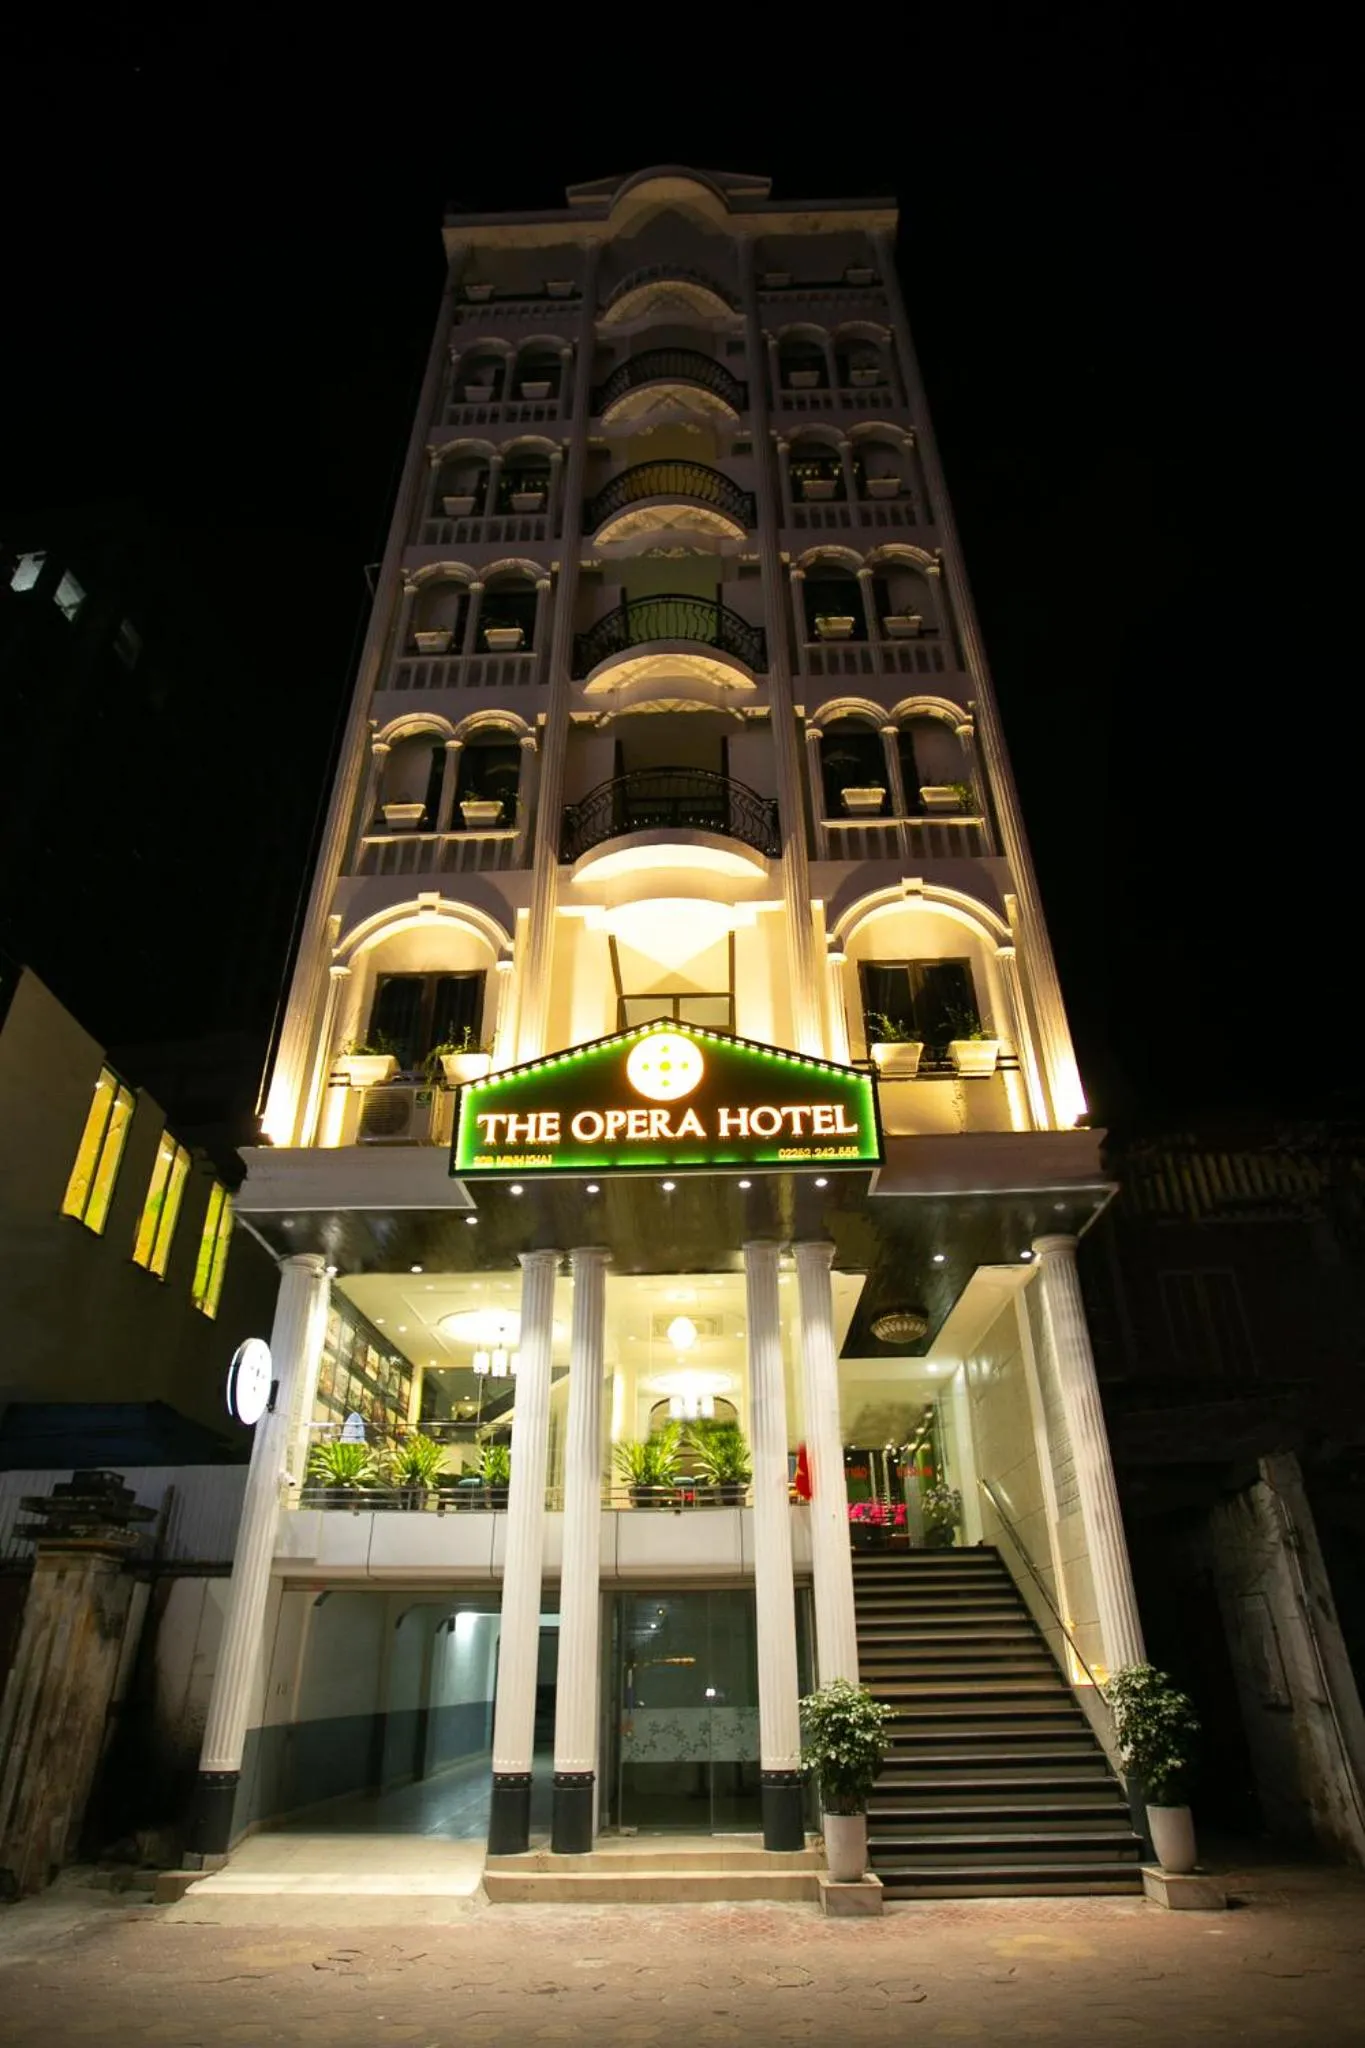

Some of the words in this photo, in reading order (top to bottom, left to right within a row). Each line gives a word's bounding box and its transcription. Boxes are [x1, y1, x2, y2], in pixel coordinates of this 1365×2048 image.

[476, 1112, 560, 1143] THE
[571, 1109, 706, 1142] OPERA
[717, 1104, 859, 1138] HOTEL
